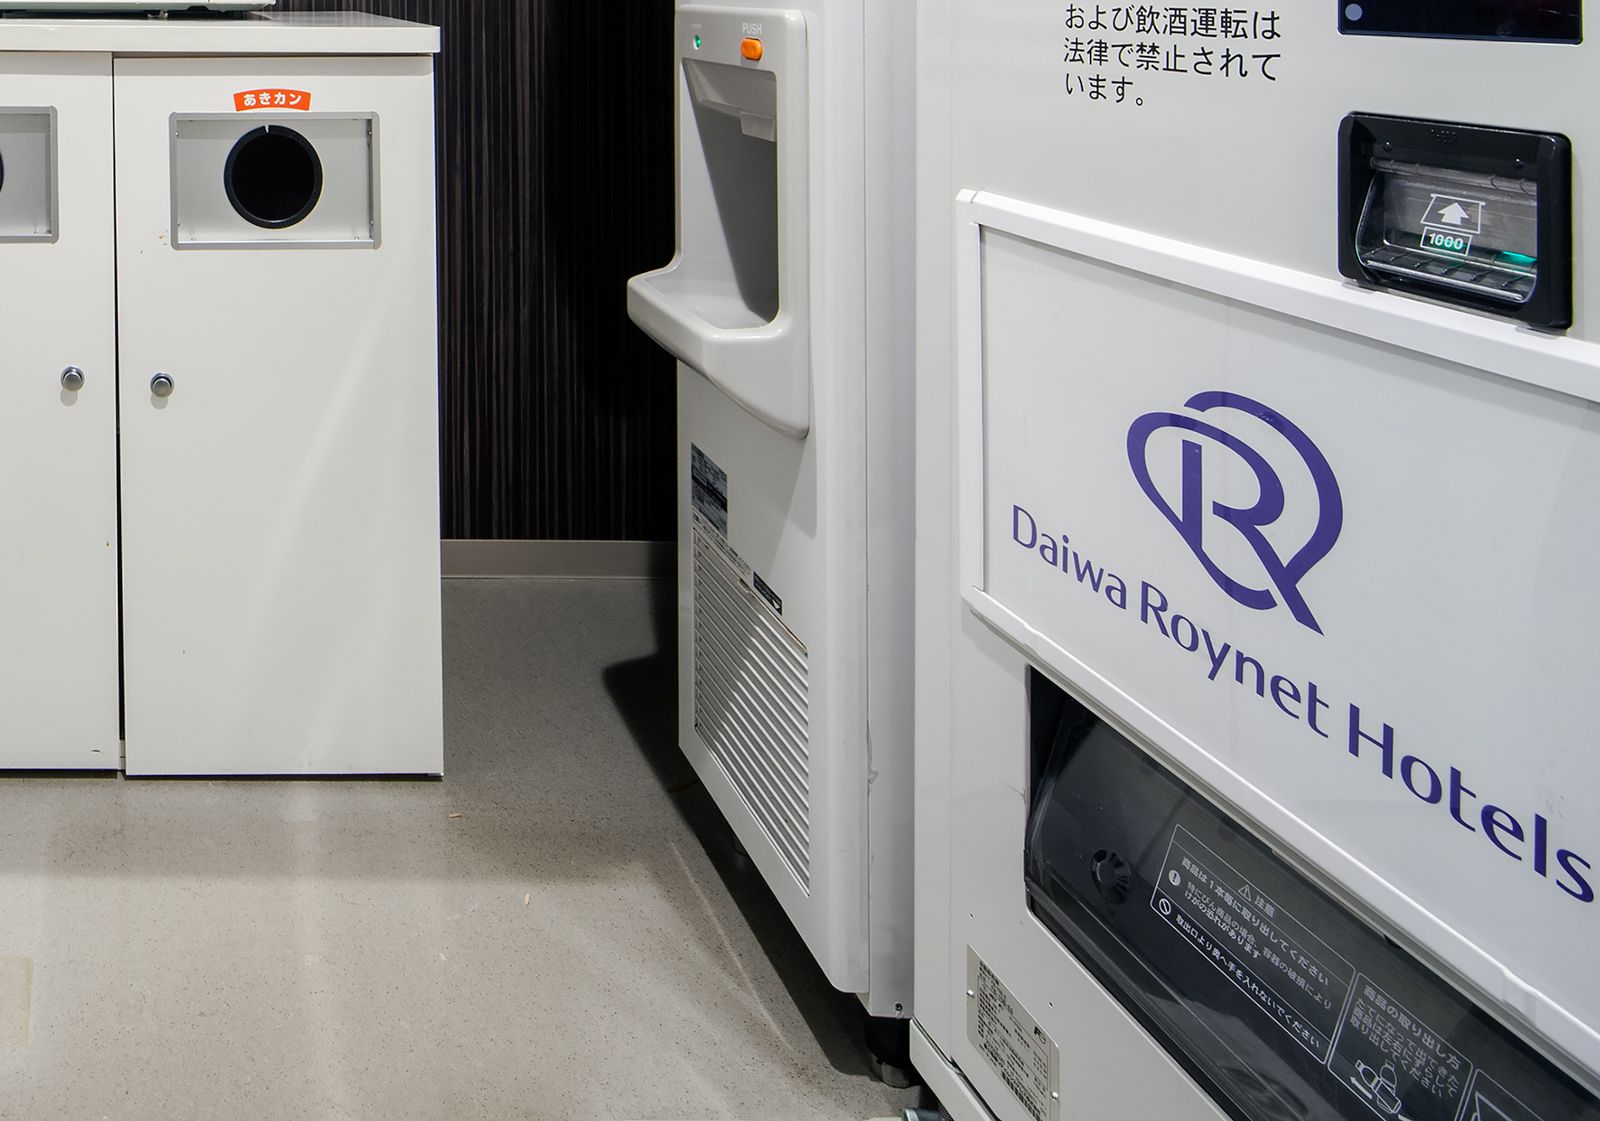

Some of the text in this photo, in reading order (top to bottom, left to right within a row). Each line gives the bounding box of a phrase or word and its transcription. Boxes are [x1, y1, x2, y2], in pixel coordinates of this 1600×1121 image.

[741, 21, 763, 35] PUSH
[1063, 2, 1283, 41] および飲酒運転は
[1063, 37, 1283, 83] 法律で禁止されて
[243, 91, 303, 107] あきカン
[1063, 72, 1146, 108] います。
[1427, 232, 1465, 251] 1000
[1011, 503, 1596, 905] Daiwa Roynet Hotels
